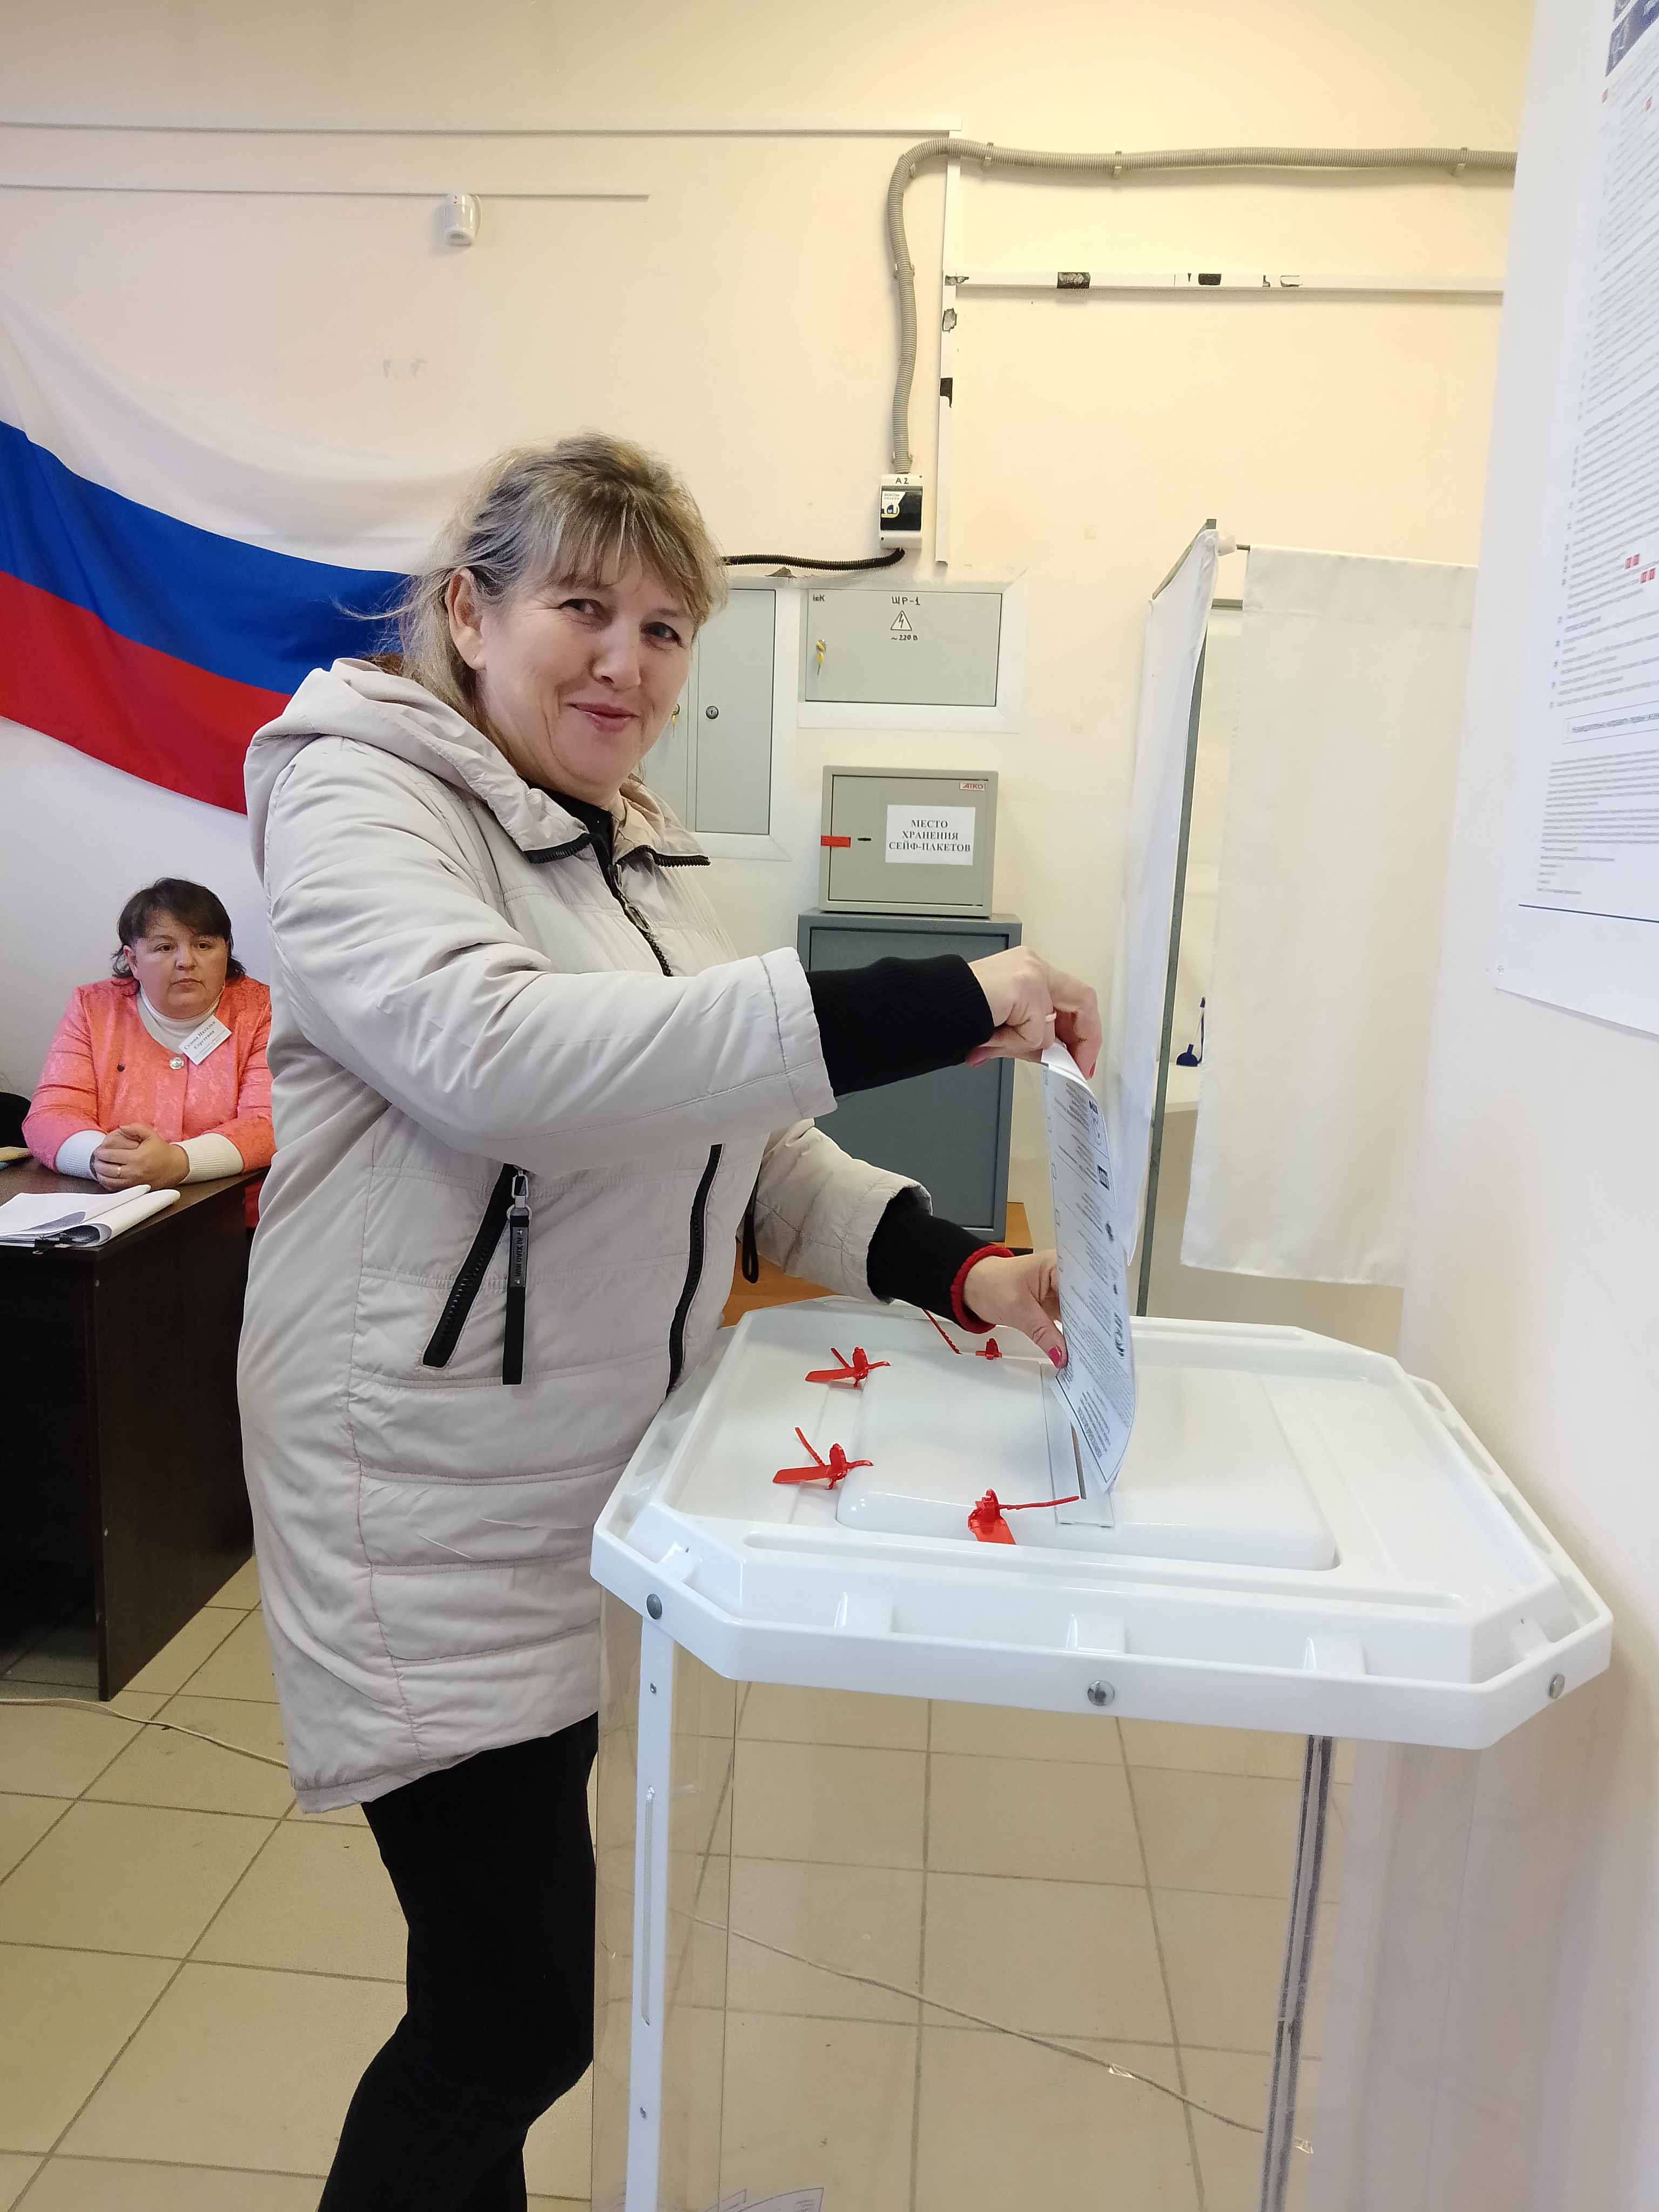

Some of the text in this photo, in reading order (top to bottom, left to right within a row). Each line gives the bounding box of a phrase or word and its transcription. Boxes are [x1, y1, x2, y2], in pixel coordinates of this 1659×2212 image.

[911, 819, 948, 828] МЕСТО
[902, 831, 959, 840] ХРАНЕНИЯ
[888, 840, 971, 852] СЕЙФ-ПАКЕТОВ
